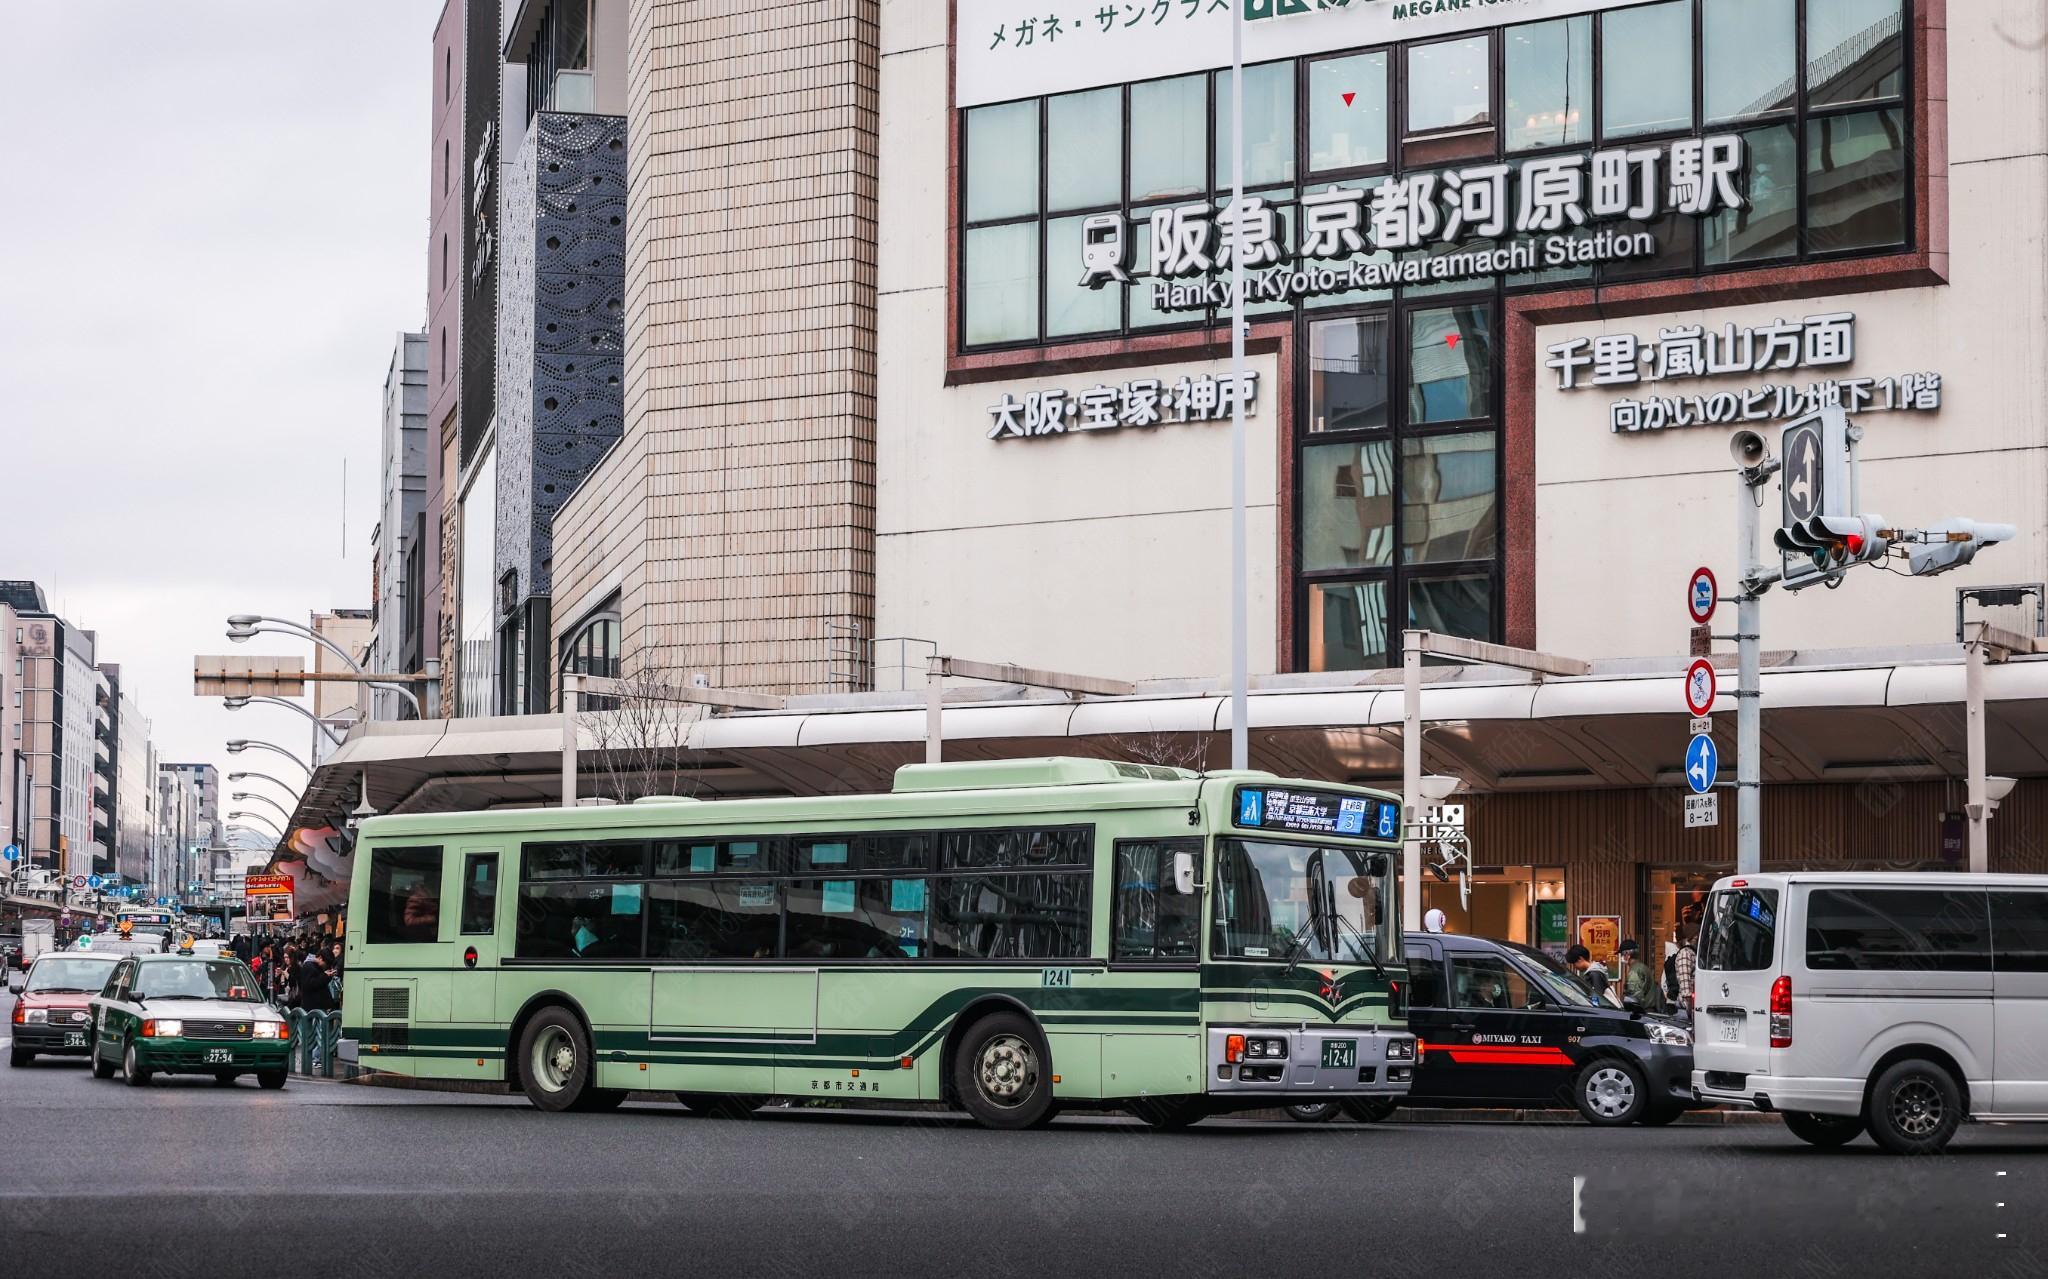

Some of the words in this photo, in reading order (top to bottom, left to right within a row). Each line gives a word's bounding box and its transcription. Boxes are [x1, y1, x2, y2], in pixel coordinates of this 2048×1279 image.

[1152, 277, 1251, 309] Hankyu
[1257, 245, 1534, 301] Kyoto-kawaramachi
[1545, 231, 1653, 270] Station
[1546, 312, 1856, 389] 千里・嵐山方面
[987, 372, 1259, 440] 大阪・宝塚・神戸
[1610, 372, 1942, 434] 向かいのビル地下1階
[1344, 813, 1356, 830] 3
[1689, 811, 1713, 823] 8-21
[1044, 969, 1069, 986] 1241
[1482, 1034, 1516, 1043] MIYAKO
[1520, 1035, 1542, 1044] TAXI
[811, 1080, 879, 1092] 京都市交通局
